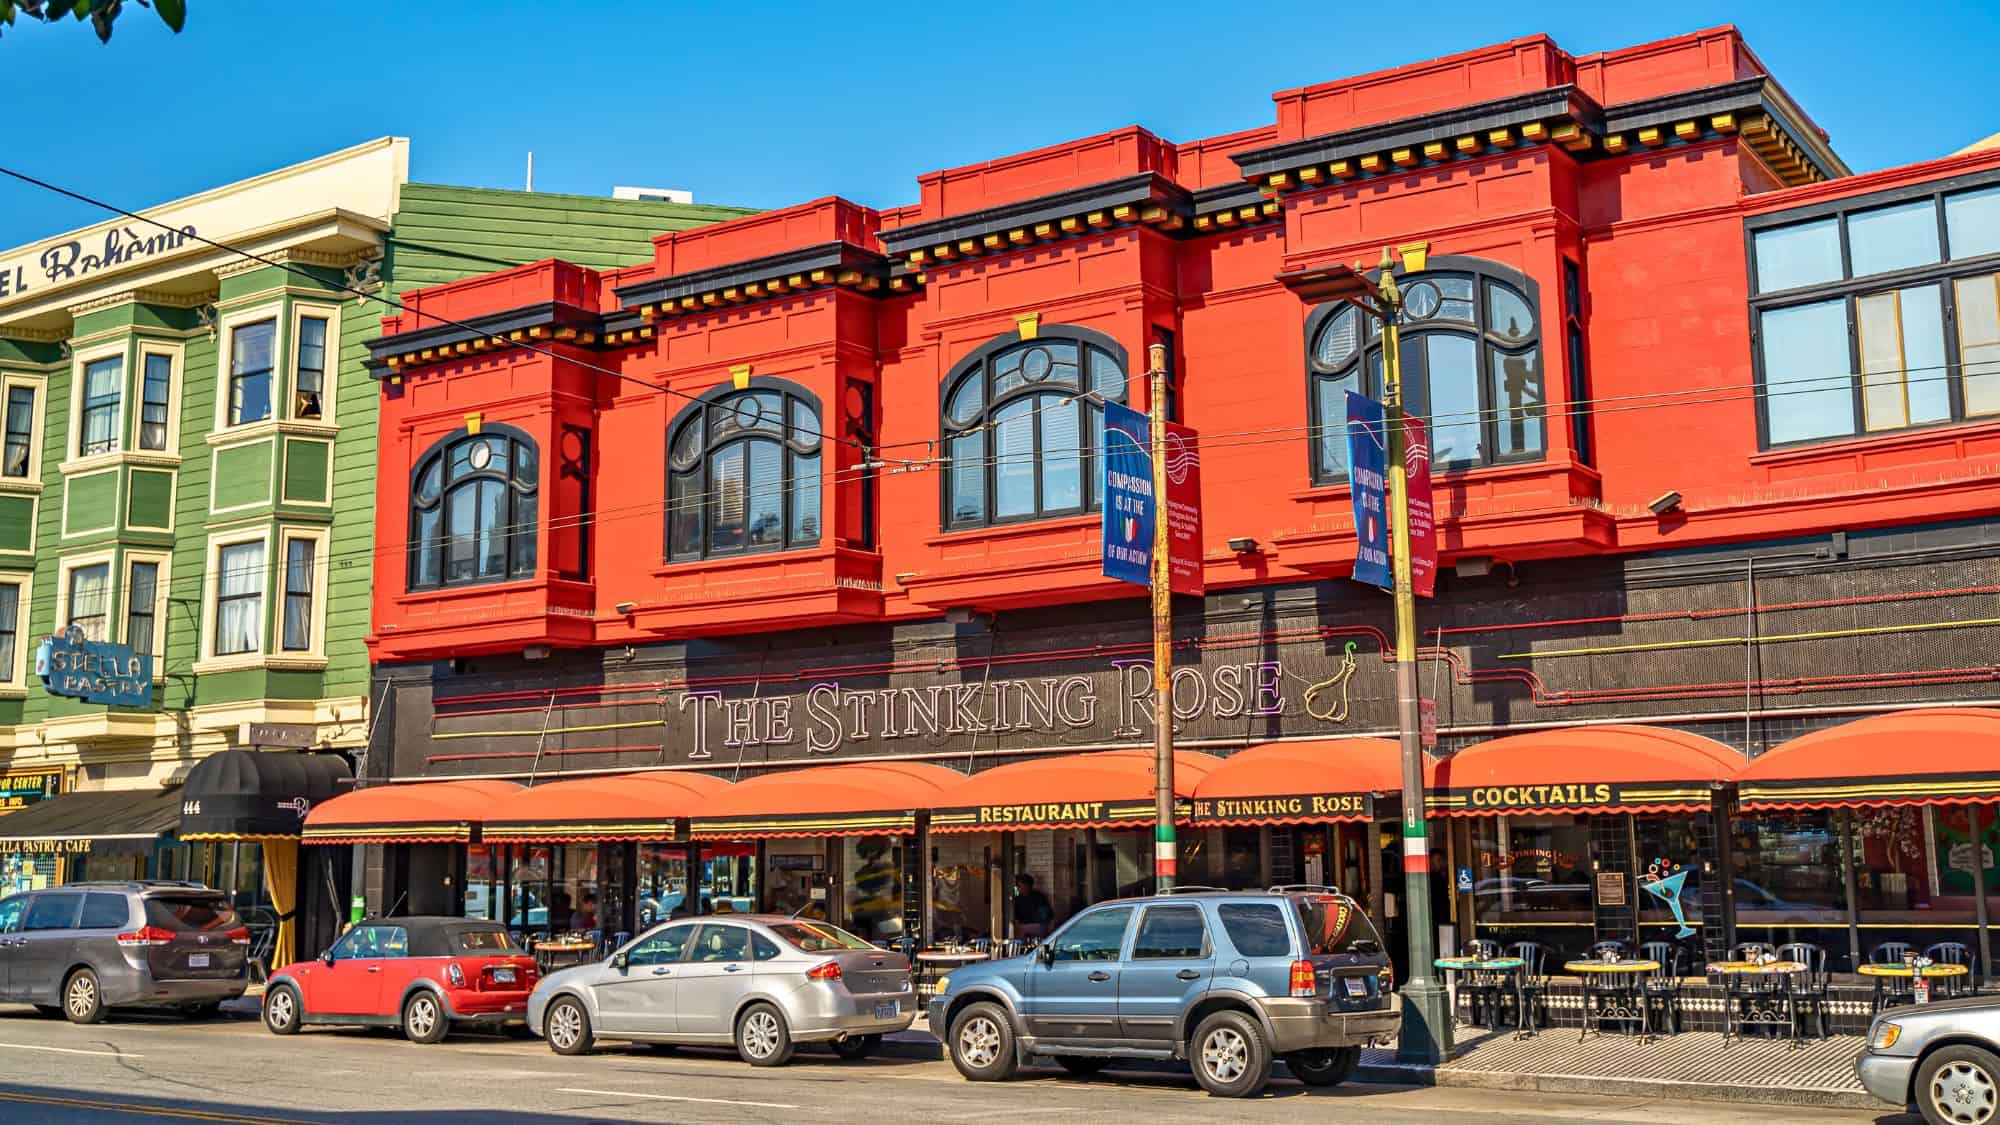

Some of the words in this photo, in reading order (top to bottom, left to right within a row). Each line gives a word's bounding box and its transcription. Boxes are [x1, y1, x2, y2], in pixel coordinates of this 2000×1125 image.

[1107, 470, 1152, 496] COMPASSION
[1115, 494, 1123, 511] IS
[1124, 496, 1132, 513] AT
[1133, 498, 1144, 516] THE
[1107, 543, 1115, 558] OF
[1117, 546, 1128, 561] OUR
[1129, 549, 1148, 566] ACTION
[51, 650, 142, 678] STELLA
[63, 675, 148, 697] PASTRY
[680, 690, 794, 759] THE
[806, 676, 1097, 753] STINKING
[1111, 658, 1287, 737] ROSE
[13, 776, 43, 791] CENTER
[1472, 784, 1611, 806] COCKTAILS
[980, 802, 1104, 823] RESTAURANT
[1216, 799, 1303, 817] STINKING
[1312, 796, 1364, 814] ROSE
[23, 839, 56, 853] PASTRY
[65, 839, 91, 853] CAFE
